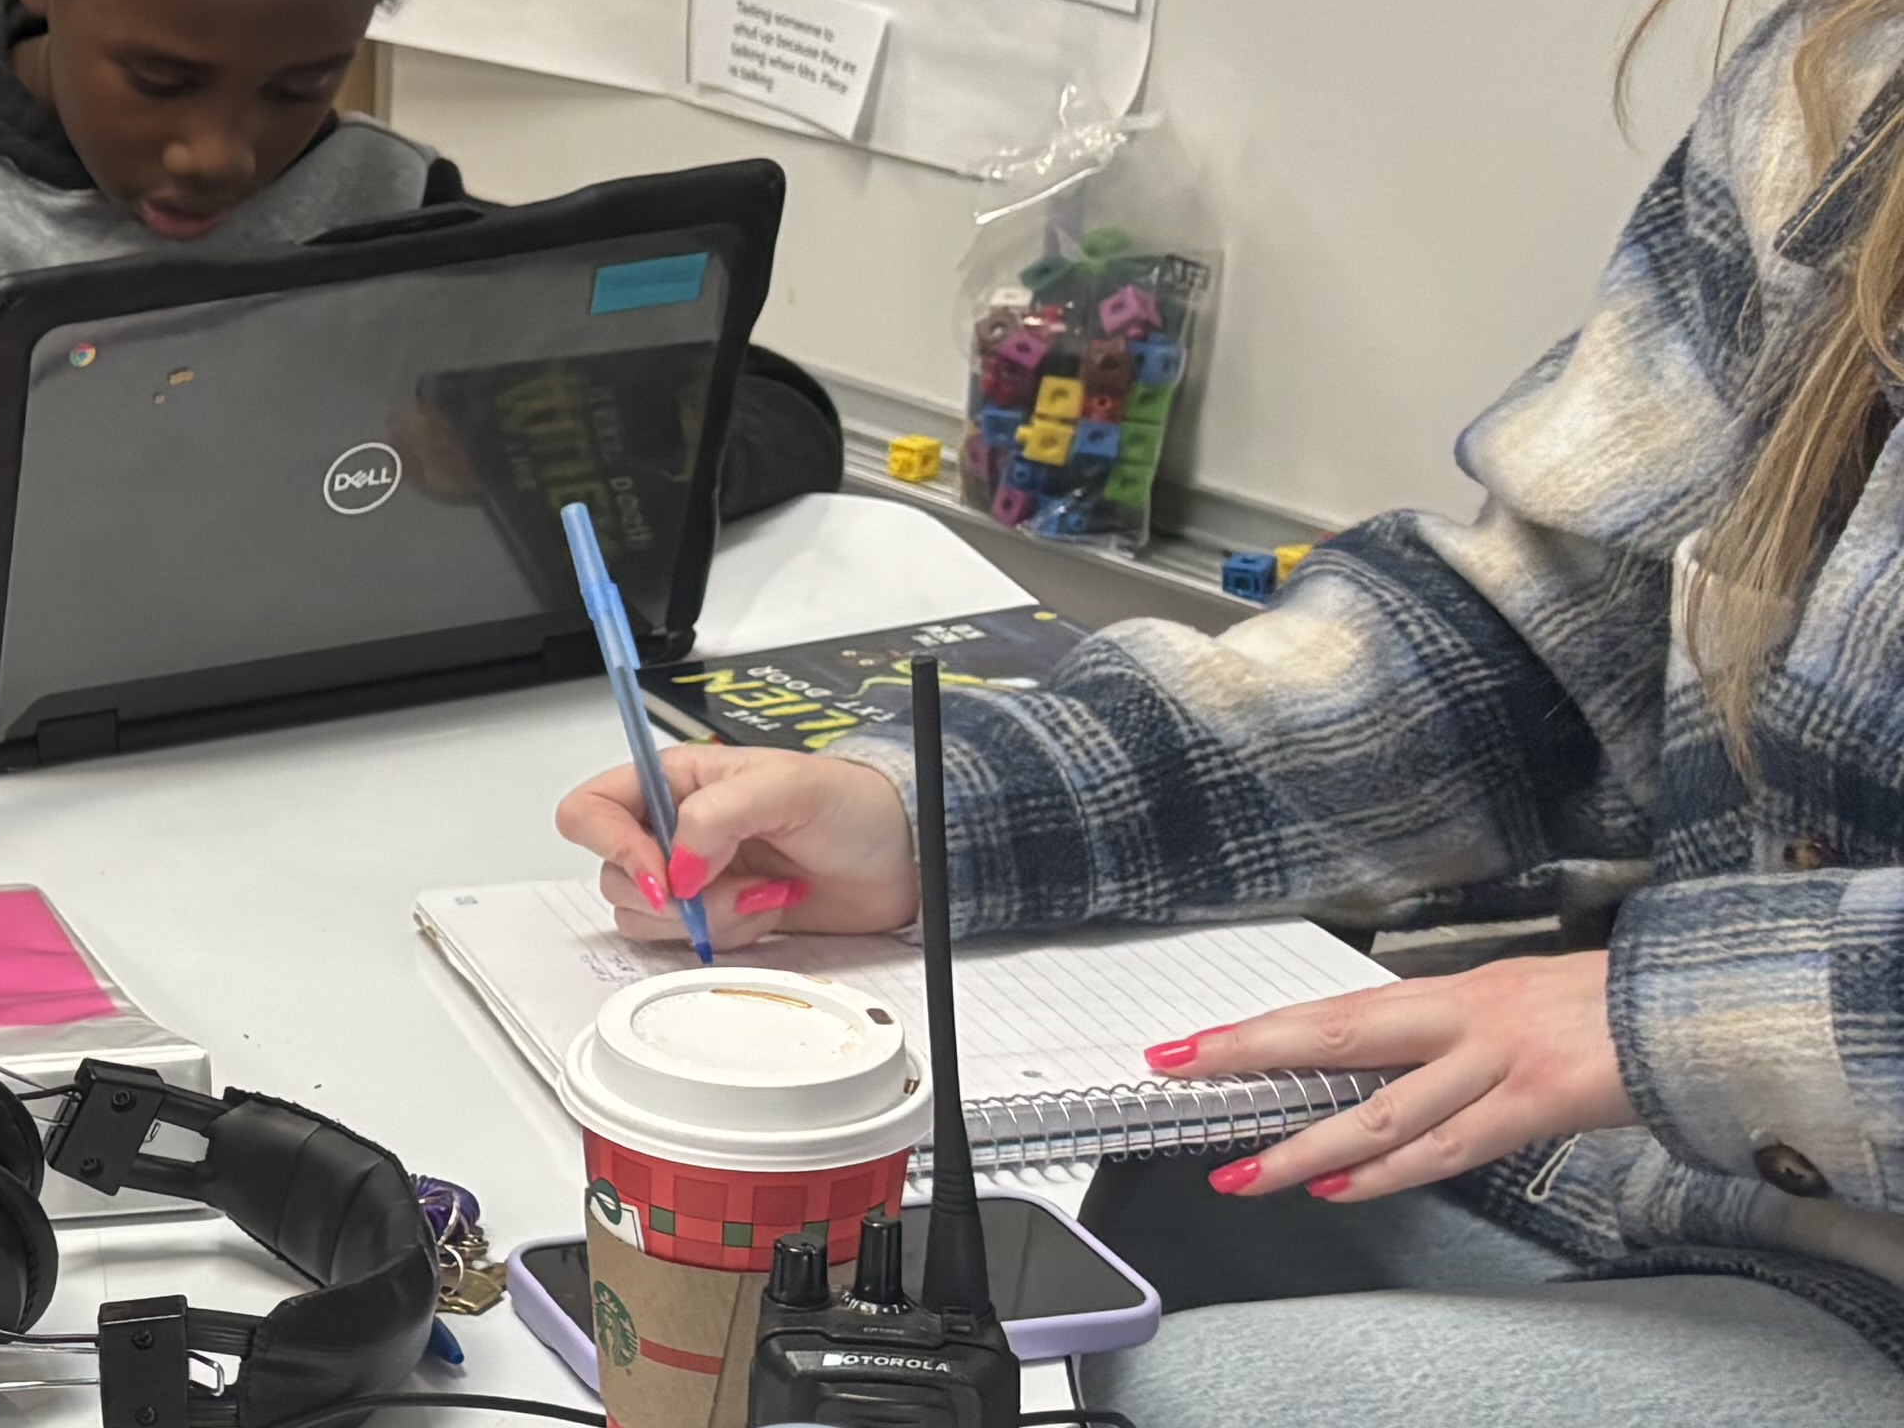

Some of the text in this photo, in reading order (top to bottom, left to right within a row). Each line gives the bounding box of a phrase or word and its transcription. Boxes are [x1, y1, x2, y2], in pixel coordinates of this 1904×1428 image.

[334, 467, 392, 492] DELL
[746, 664, 834, 700] DOOR
[721, 708, 781, 733] THE
